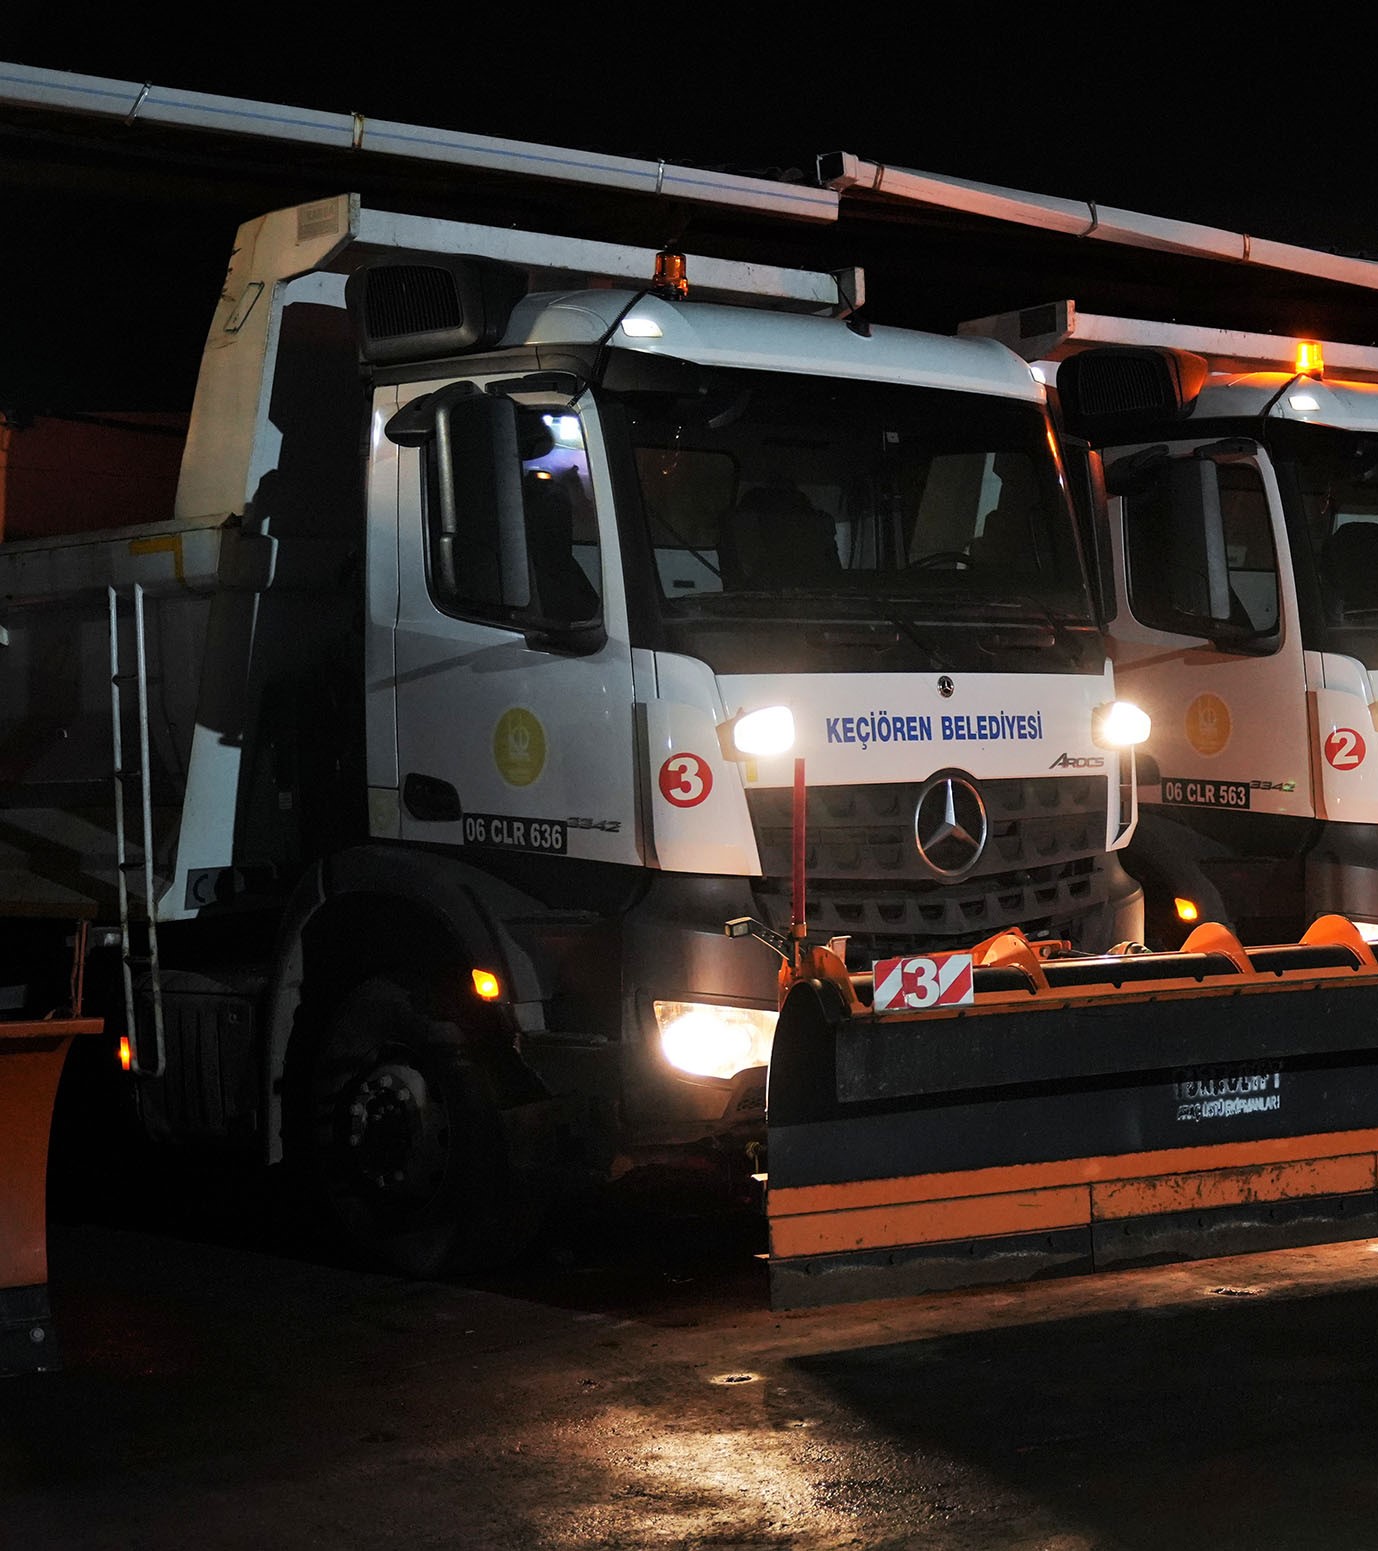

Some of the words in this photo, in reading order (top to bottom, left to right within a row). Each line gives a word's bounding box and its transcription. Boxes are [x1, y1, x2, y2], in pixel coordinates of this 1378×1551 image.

[825, 710, 932, 750] KEÇİÖREN
[941, 710, 1043, 741] BELEDİYESİ
[1331, 731, 1359, 765] 2
[667, 756, 704, 801] 3
[1165, 781, 1182, 801] 06
[1186, 783, 1216, 803] CLR
[1219, 785, 1246, 806] 563
[1250, 780, 1296, 792] 3342
[465, 818, 486, 842] 06
[491, 820, 526, 845] CLR
[530, 823, 562, 849] 636
[903, 958, 941, 1008] 3
